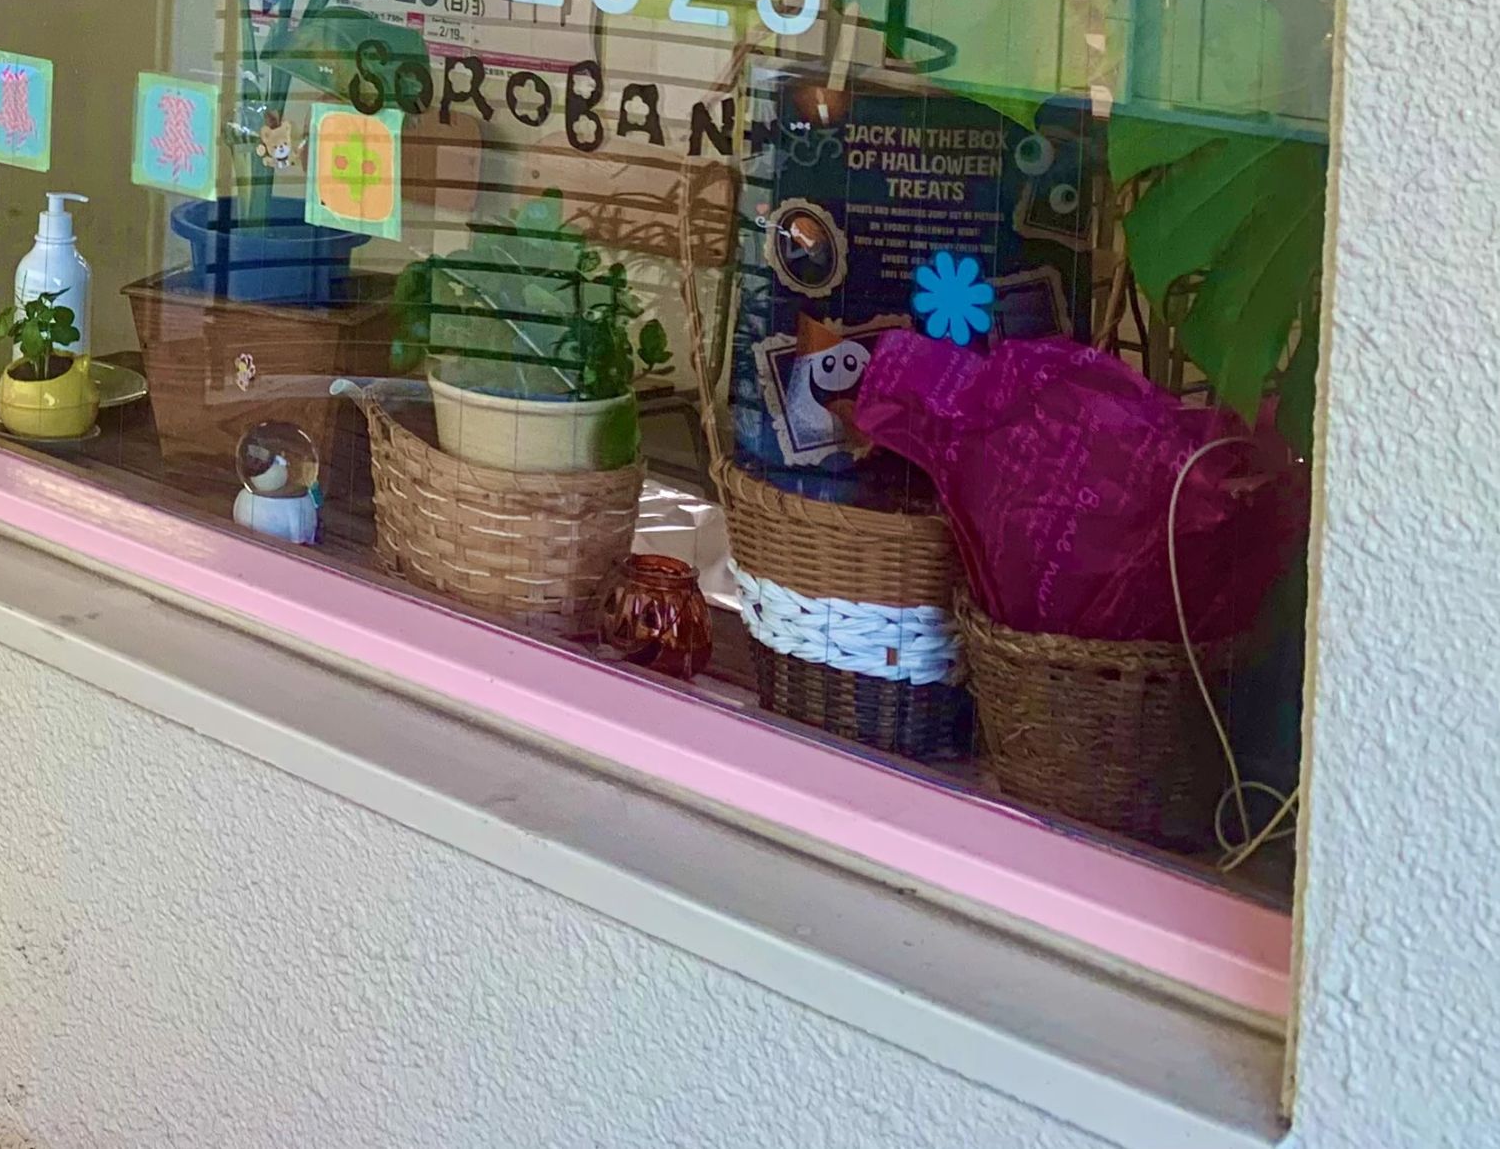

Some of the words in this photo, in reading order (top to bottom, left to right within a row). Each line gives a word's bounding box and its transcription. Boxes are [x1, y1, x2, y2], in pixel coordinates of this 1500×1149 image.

[349, 39, 735, 156] SOROBAN
[844, 124, 897, 145] JACK
[901, 127, 922, 148] IN
[924, 128, 966, 149] THE
[968, 131, 1008, 150] BOX
[848, 150, 877, 170] OF
[881, 152, 1003, 177] HALLOWEEN
[886, 178, 965, 201] TREATS
